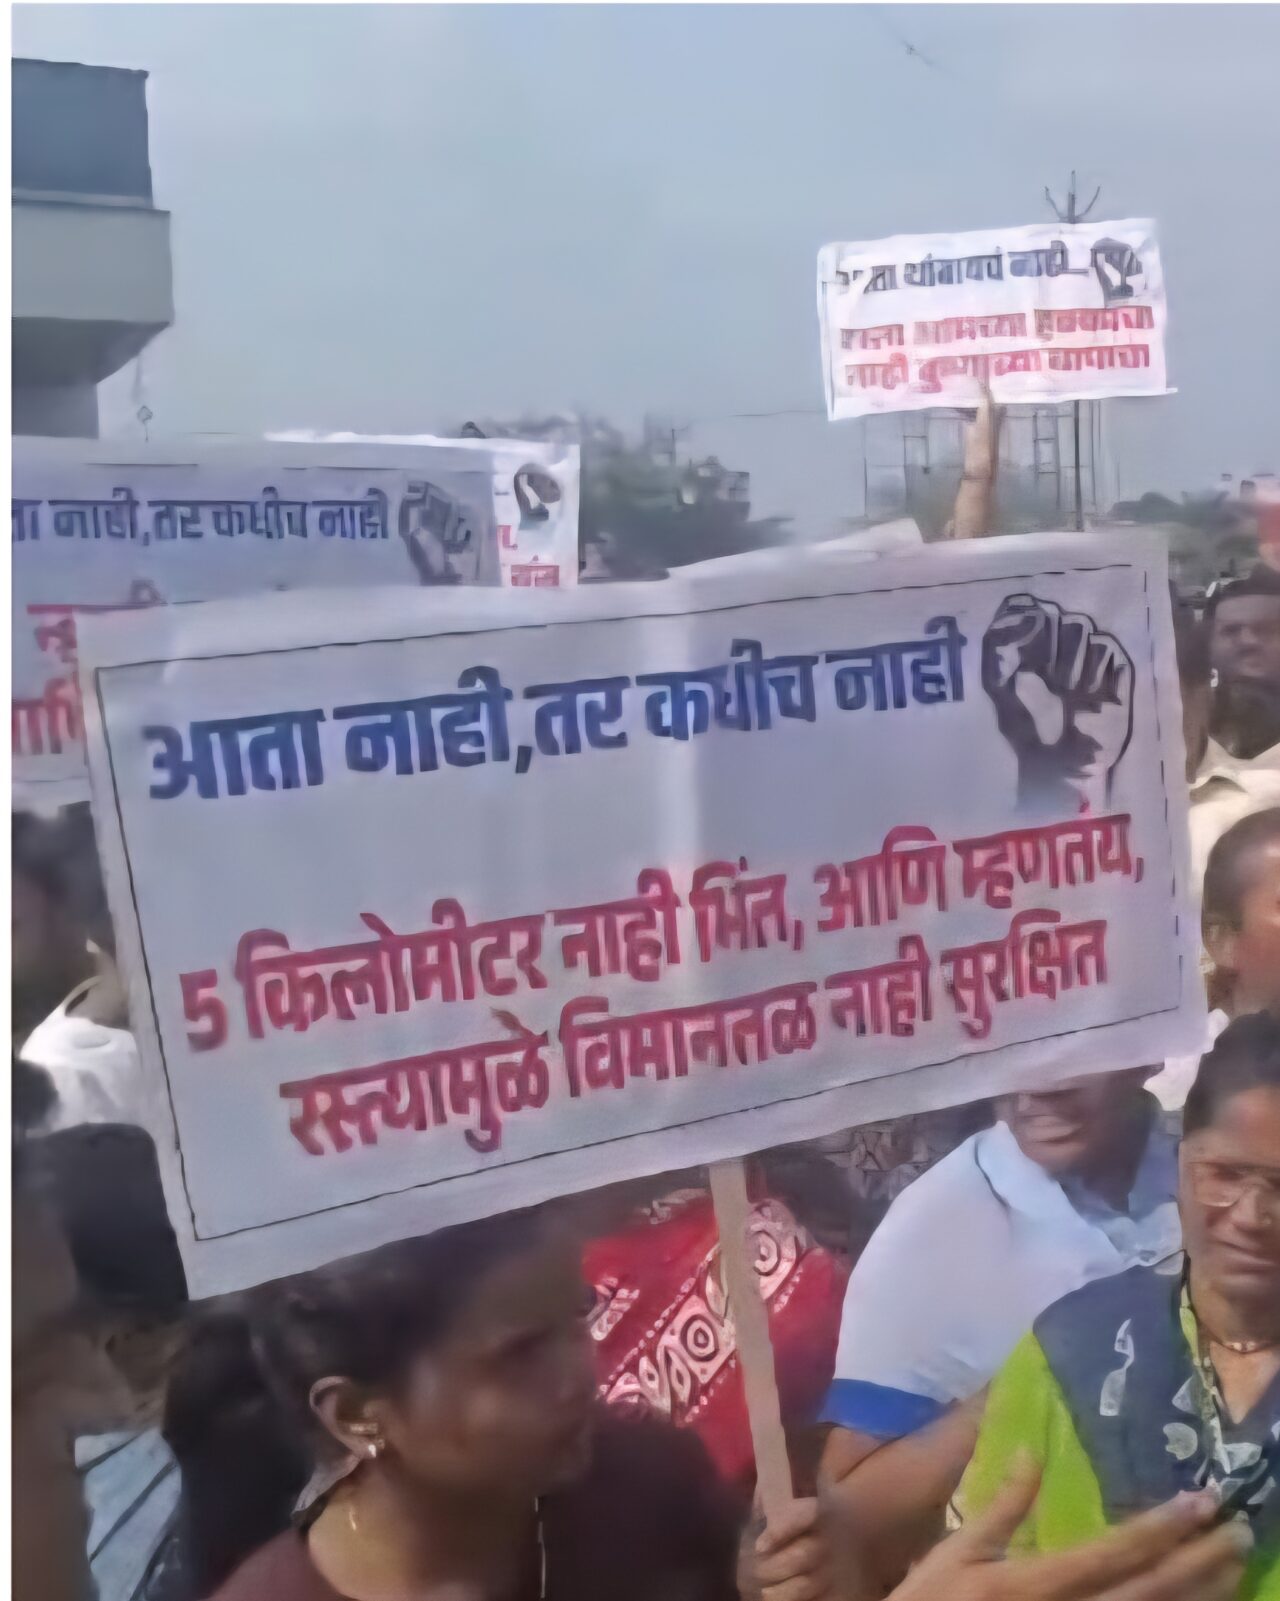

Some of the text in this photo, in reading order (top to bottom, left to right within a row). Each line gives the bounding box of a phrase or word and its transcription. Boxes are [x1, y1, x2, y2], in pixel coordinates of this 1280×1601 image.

[311, 487, 390, 540] नाही
[143, 709, 326, 799] आता
[636, 638, 818, 740] कधीच
[825, 616, 967, 712] नाही
[179, 969, 228, 1051] 5
[234, 898, 548, 1038] किलोमीटर
[546, 867, 682, 982] नाही
[689, 856, 804, 963] भिंत,
[814, 825, 946, 932] आणि
[280, 908, 1107, 1156] रस्त्यामुळे विमानतळ नाही सुरक्षित
